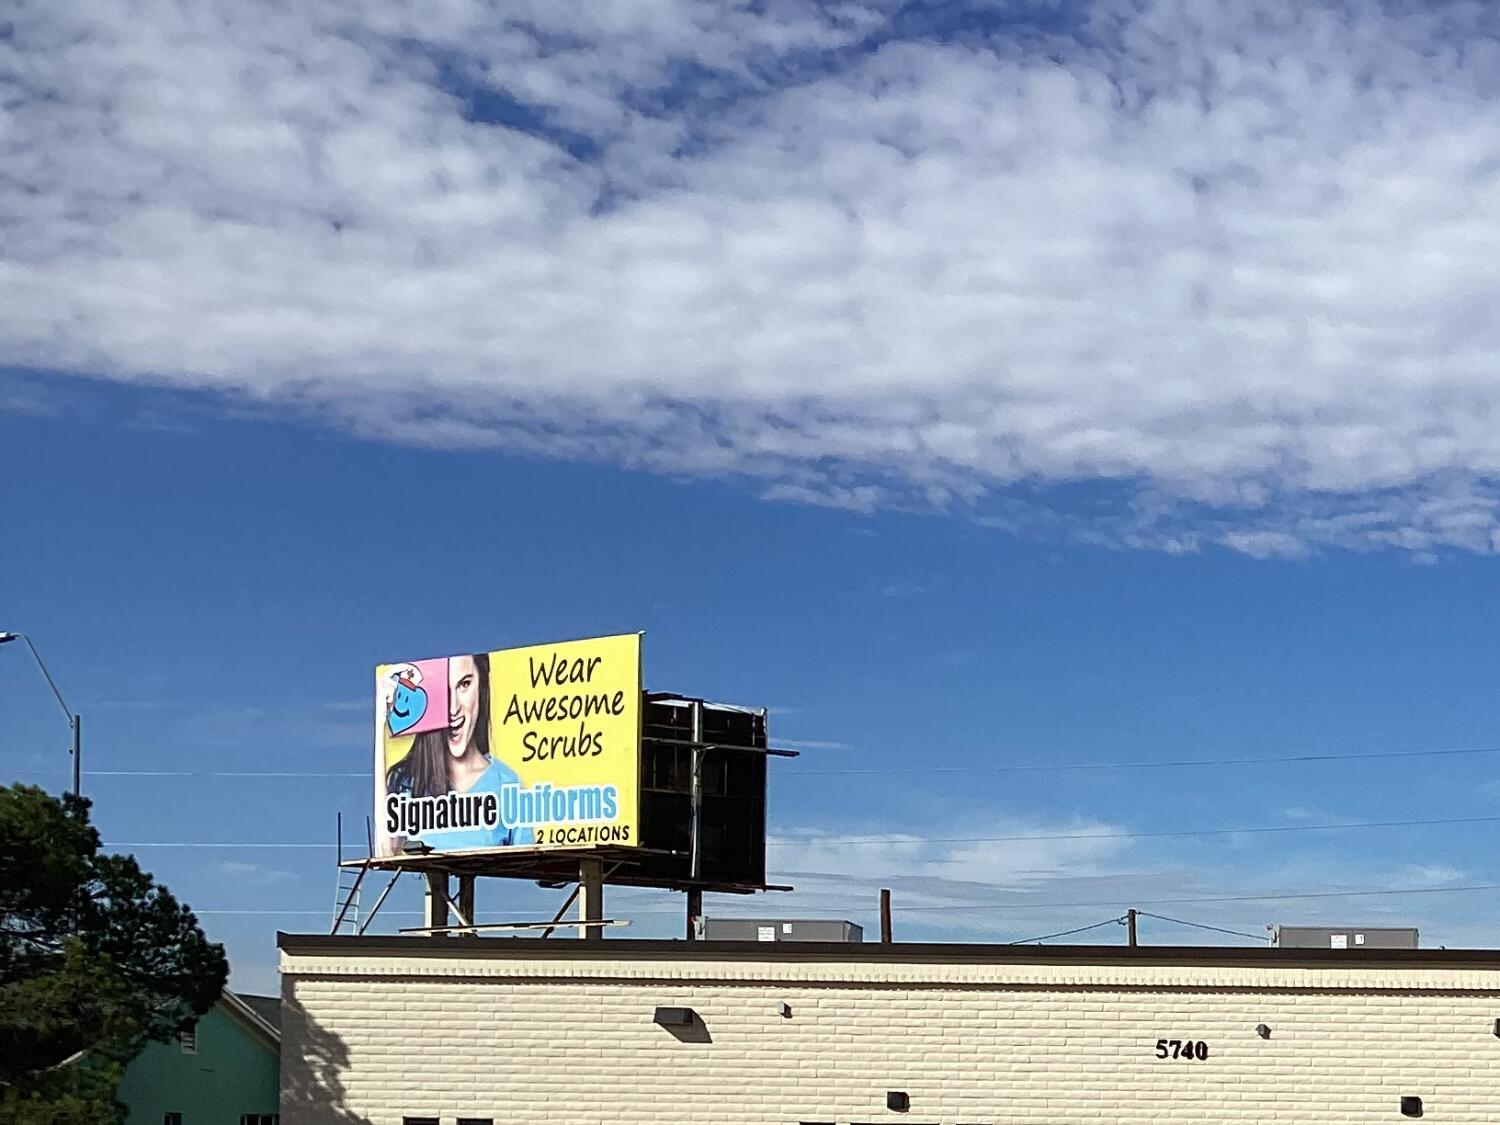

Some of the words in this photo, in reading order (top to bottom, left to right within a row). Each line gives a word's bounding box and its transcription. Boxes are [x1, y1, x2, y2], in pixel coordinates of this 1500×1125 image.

[529, 653, 601, 688] Wear
[503, 690, 625, 725] Awesome
[522, 721, 602, 761] Scrubs
[386, 793, 497, 835] Signature
[503, 785, 617, 825] Uniforms
[536, 829, 545, 844] 2
[549, 825, 630, 844] LOCATIONS
[1155, 1039, 1208, 1061] 5740
